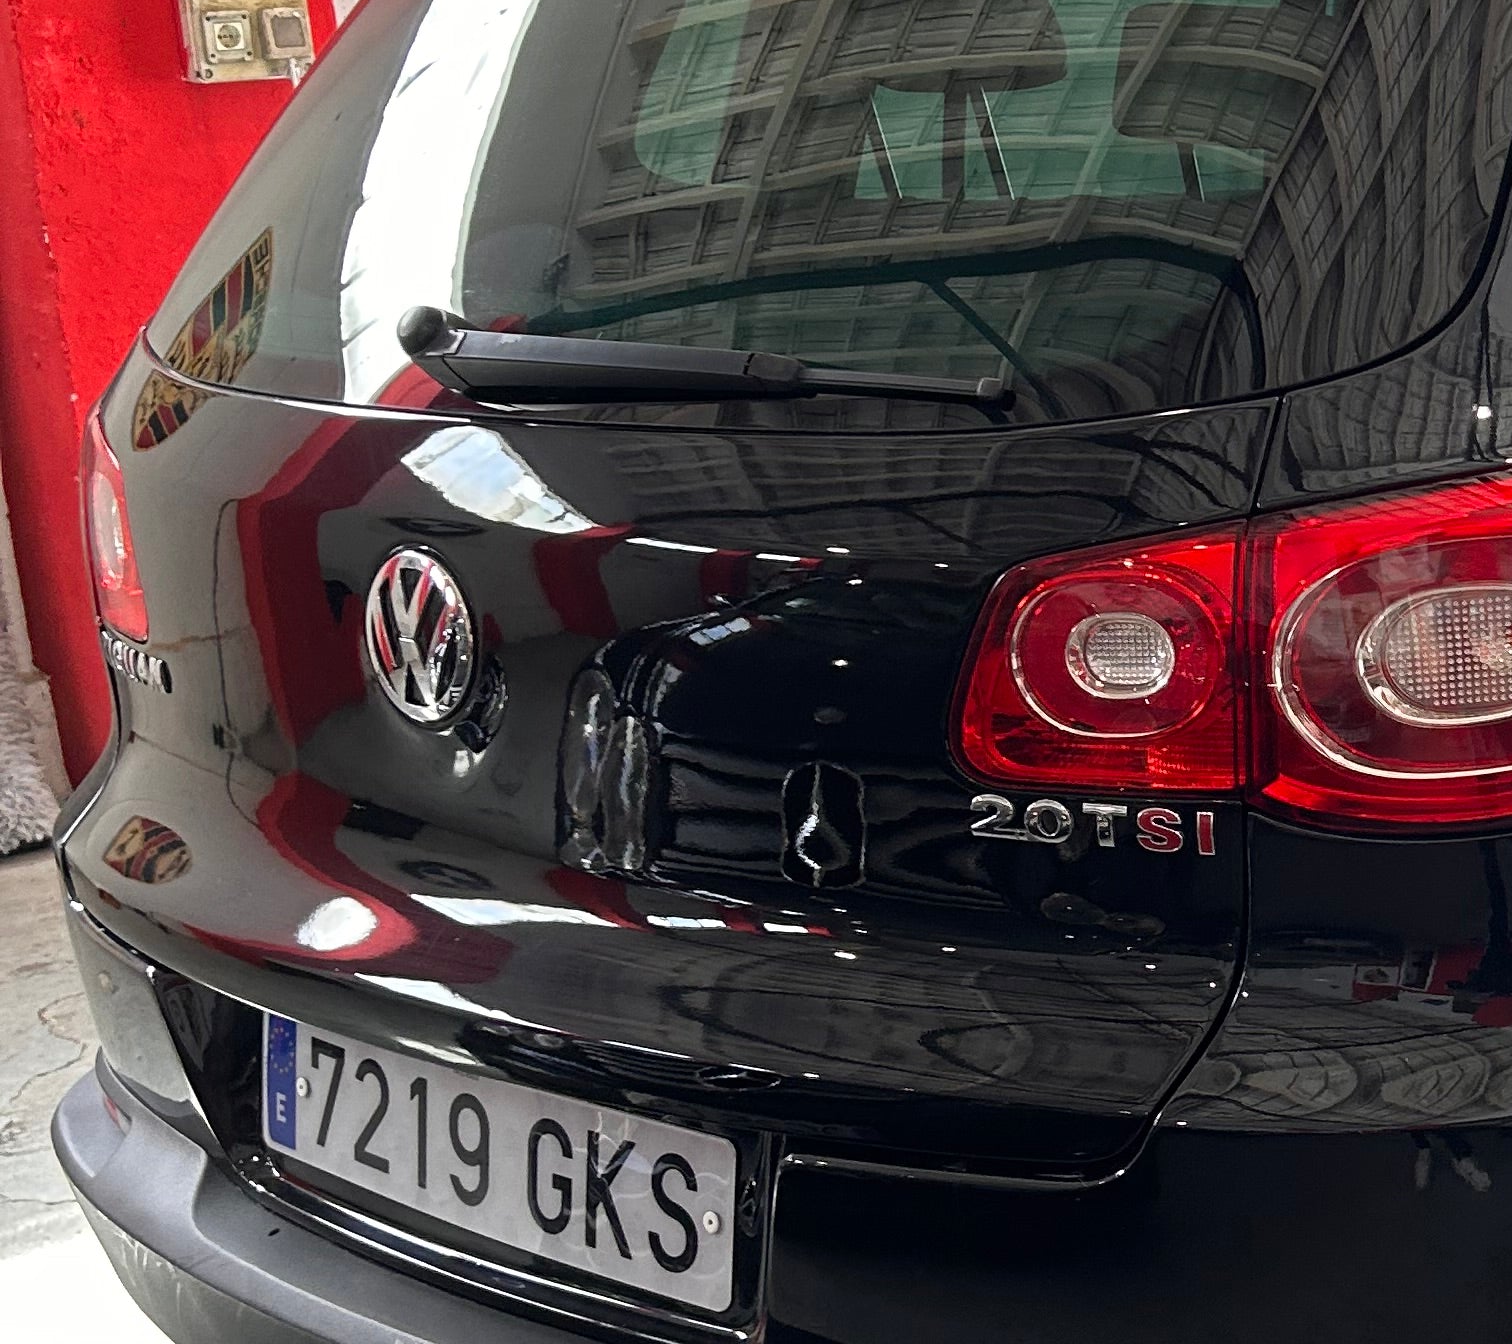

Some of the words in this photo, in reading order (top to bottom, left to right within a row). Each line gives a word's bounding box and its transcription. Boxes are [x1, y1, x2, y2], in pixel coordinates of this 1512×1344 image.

[275, 1093, 289, 1124] E
[310, 1037, 491, 1208] 7219
[527, 1117, 699, 1274] GKS
